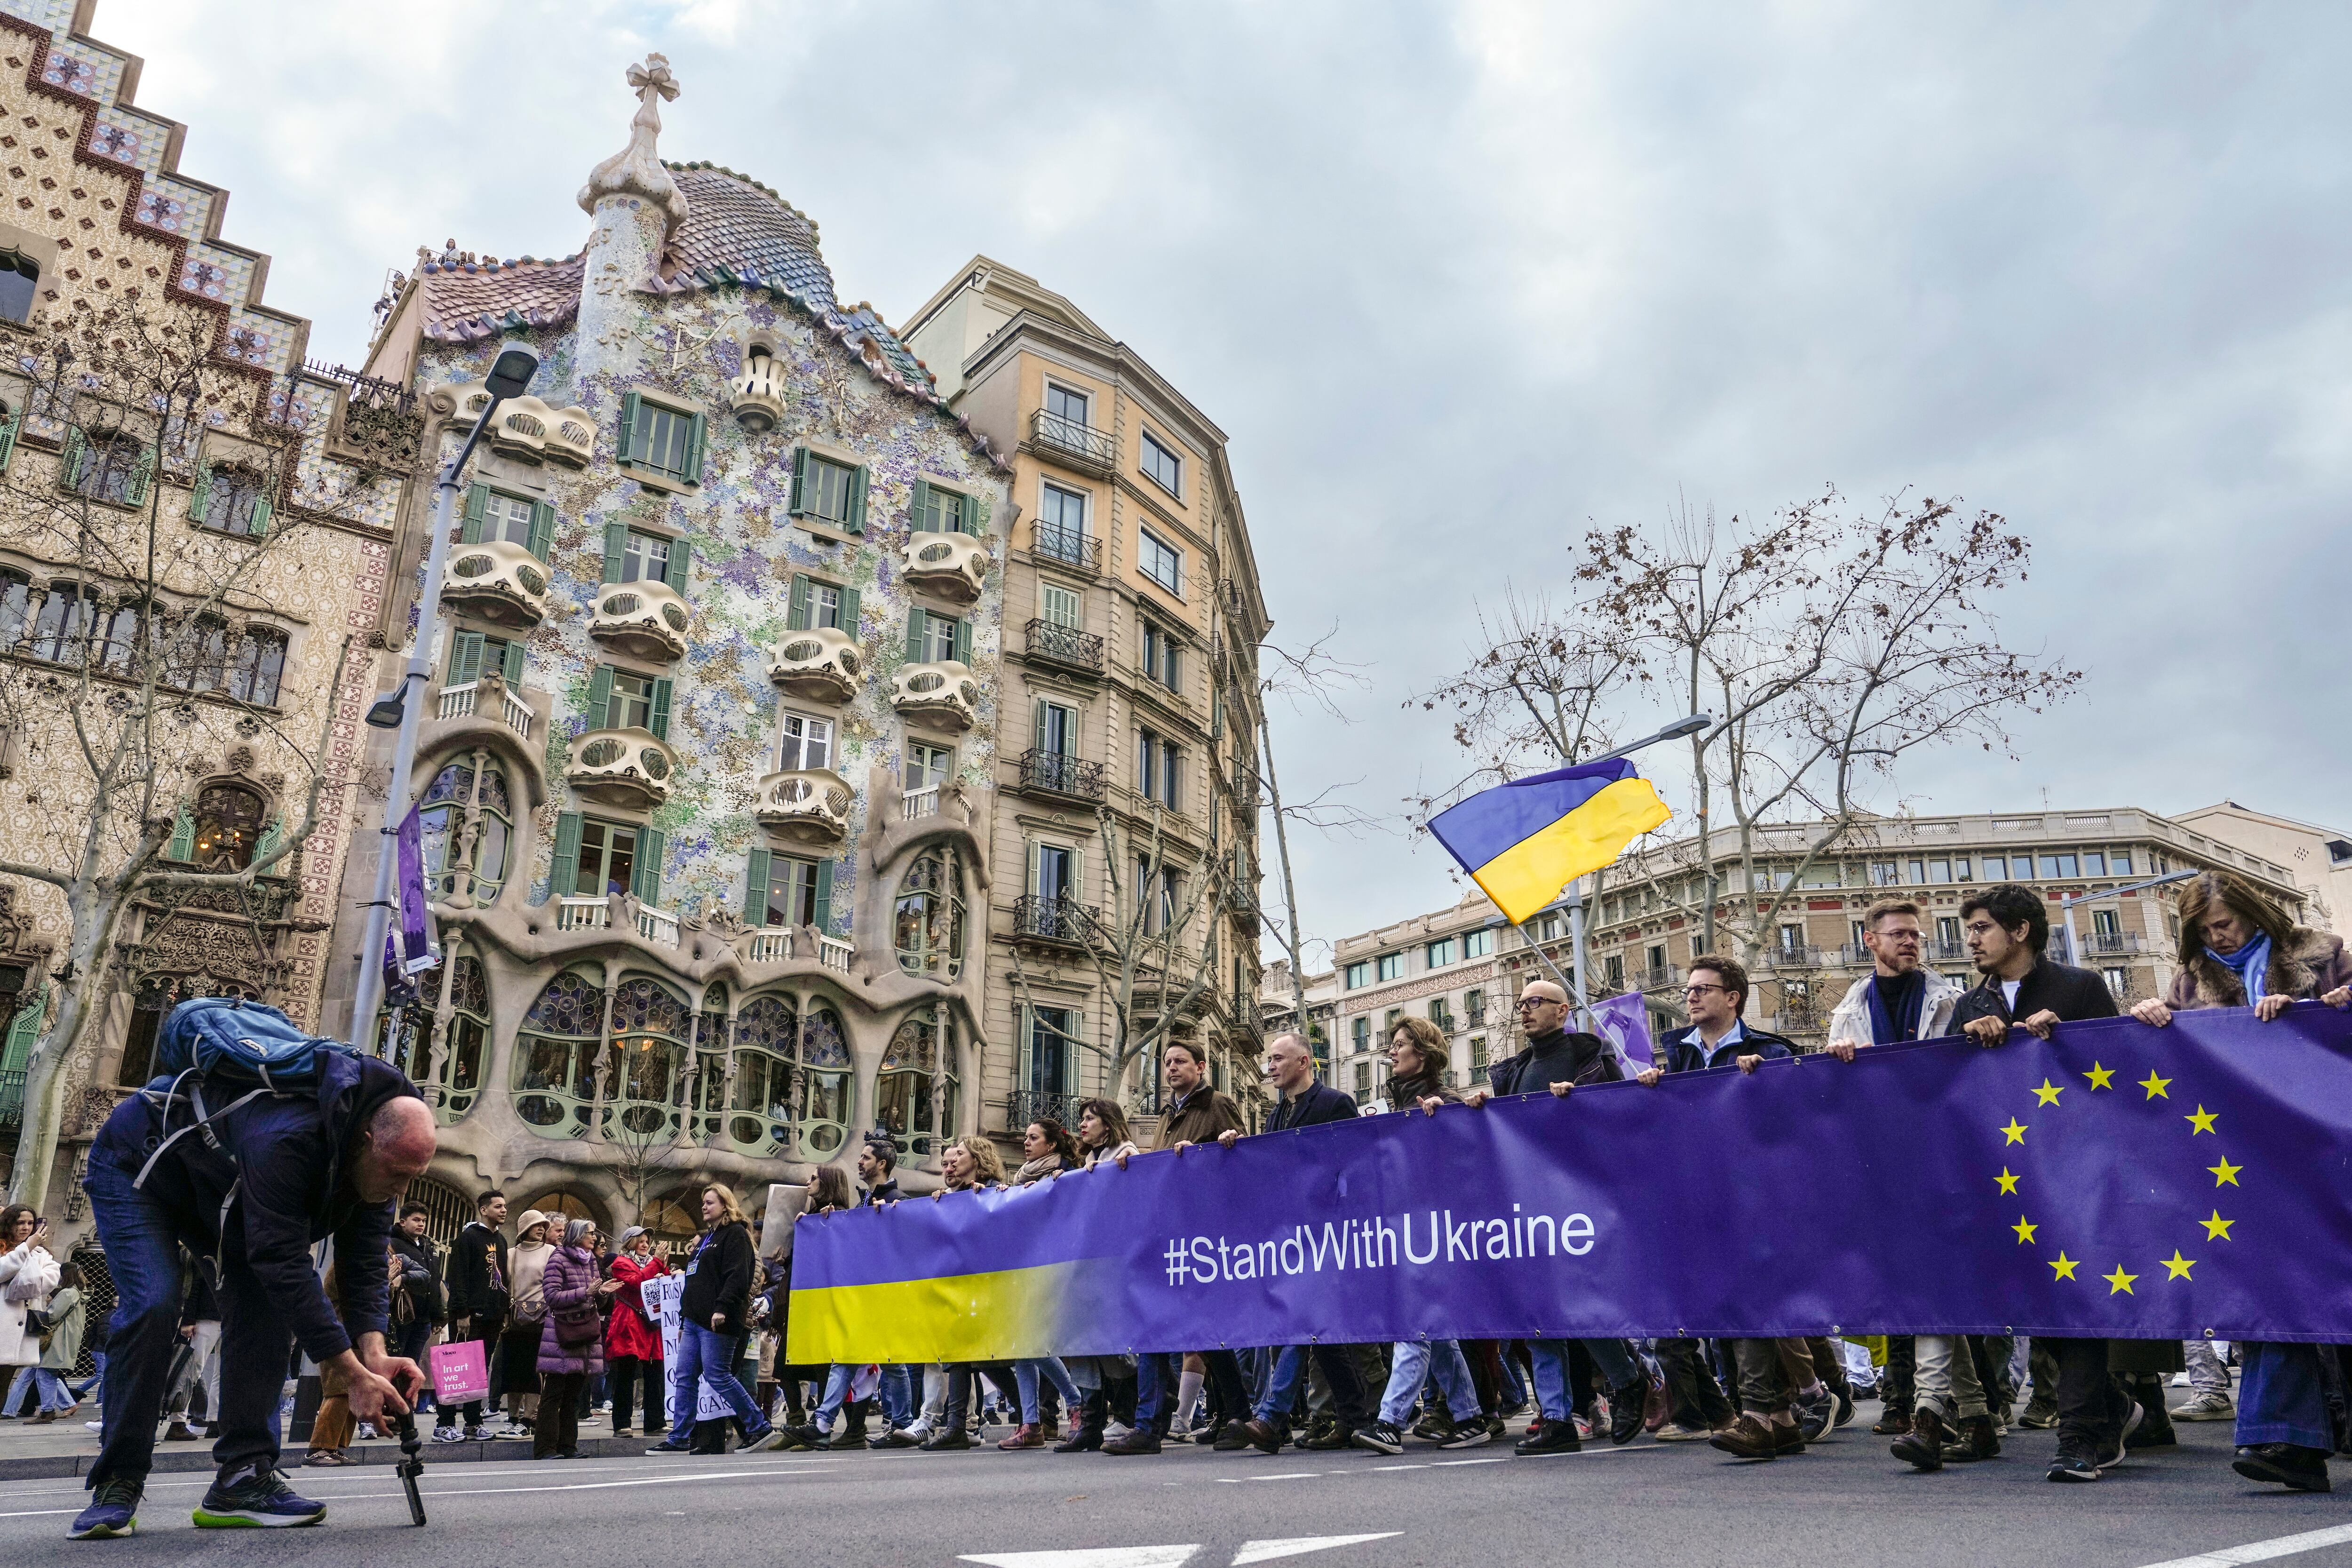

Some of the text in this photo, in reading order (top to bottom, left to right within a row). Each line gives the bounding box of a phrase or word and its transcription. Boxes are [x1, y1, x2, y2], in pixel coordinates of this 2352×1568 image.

[1164, 1203, 1595, 1286] #StandWithUkraine
[443, 1363, 469, 1374] In art
[444, 1381, 469, 1391] trust.
